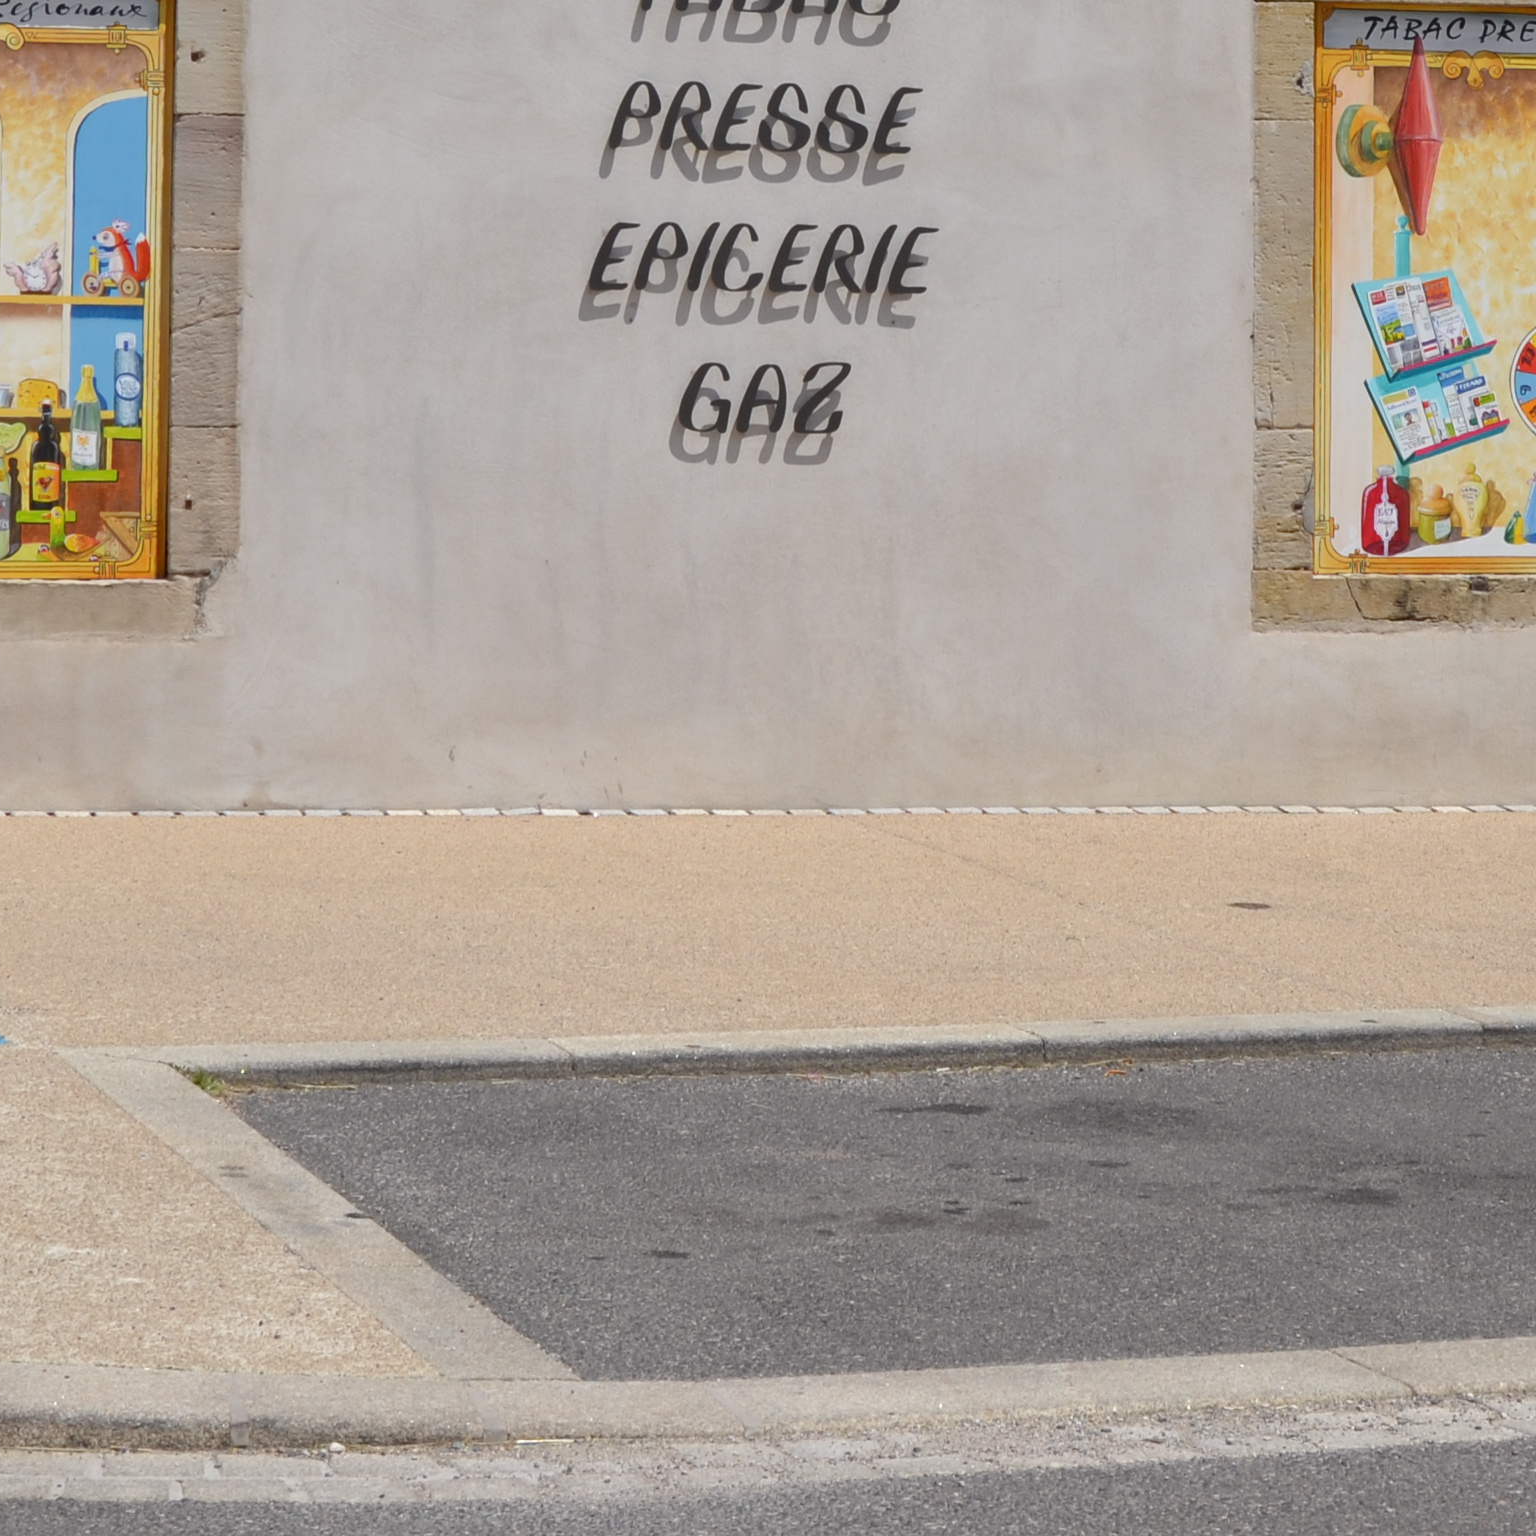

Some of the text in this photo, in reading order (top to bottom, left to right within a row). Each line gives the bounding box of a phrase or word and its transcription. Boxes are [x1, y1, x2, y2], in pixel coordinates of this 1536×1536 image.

[1363, 15, 1466, 41] TABAC
[608, 79, 924, 154] PRESSE
[588, 221, 940, 295] EPICERIE
[677, 361, 852, 434] GAZ
